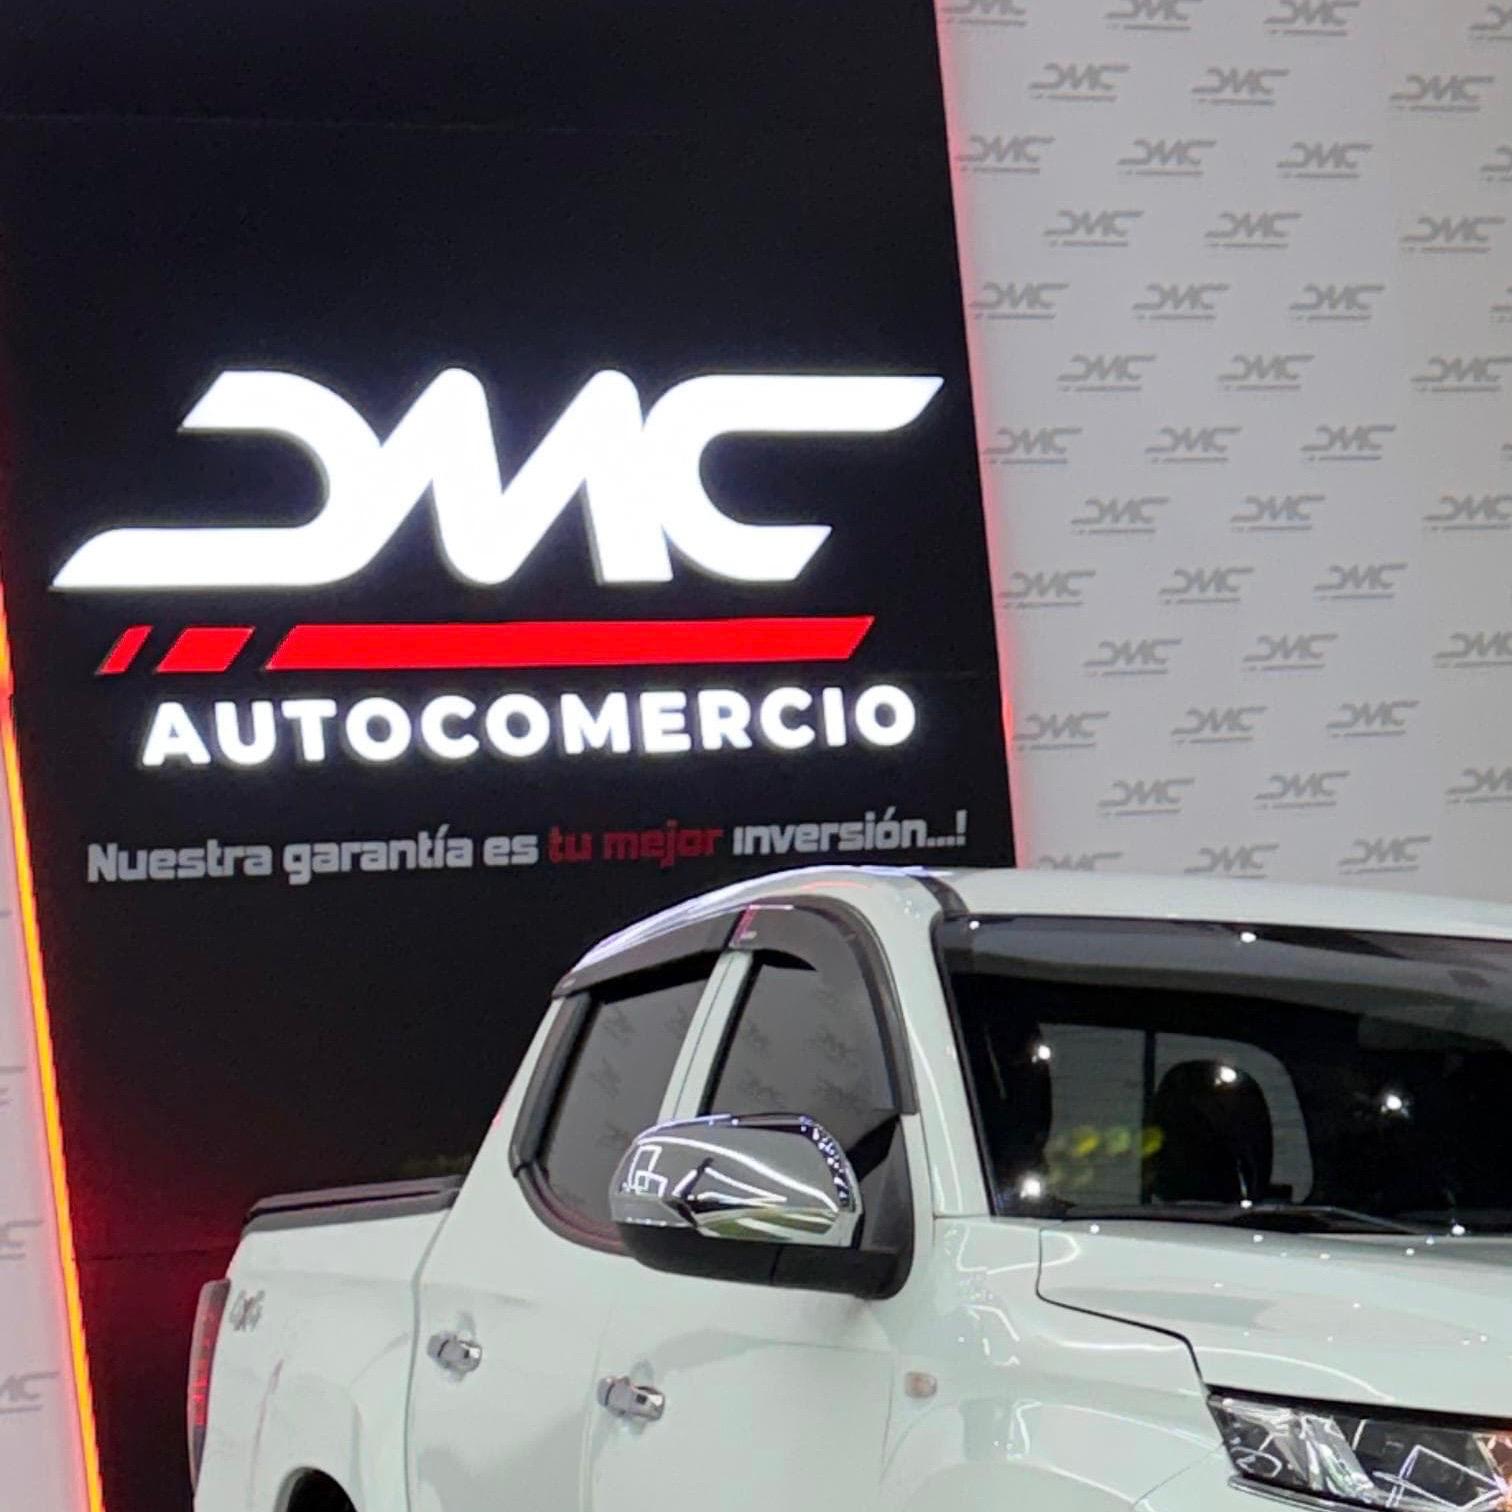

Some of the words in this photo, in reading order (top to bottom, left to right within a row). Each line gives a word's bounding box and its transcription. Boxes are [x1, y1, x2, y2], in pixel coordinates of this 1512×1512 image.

[51, 367, 944, 588] DMC
[142, 684, 916, 766] AUTOCOMERCIO
[88, 838, 273, 883] Nuestra
[283, 824, 474, 886] garantía
[483, 833, 540, 867] es
[548, 826, 592, 863] tu
[604, 819, 723, 868] mejor
